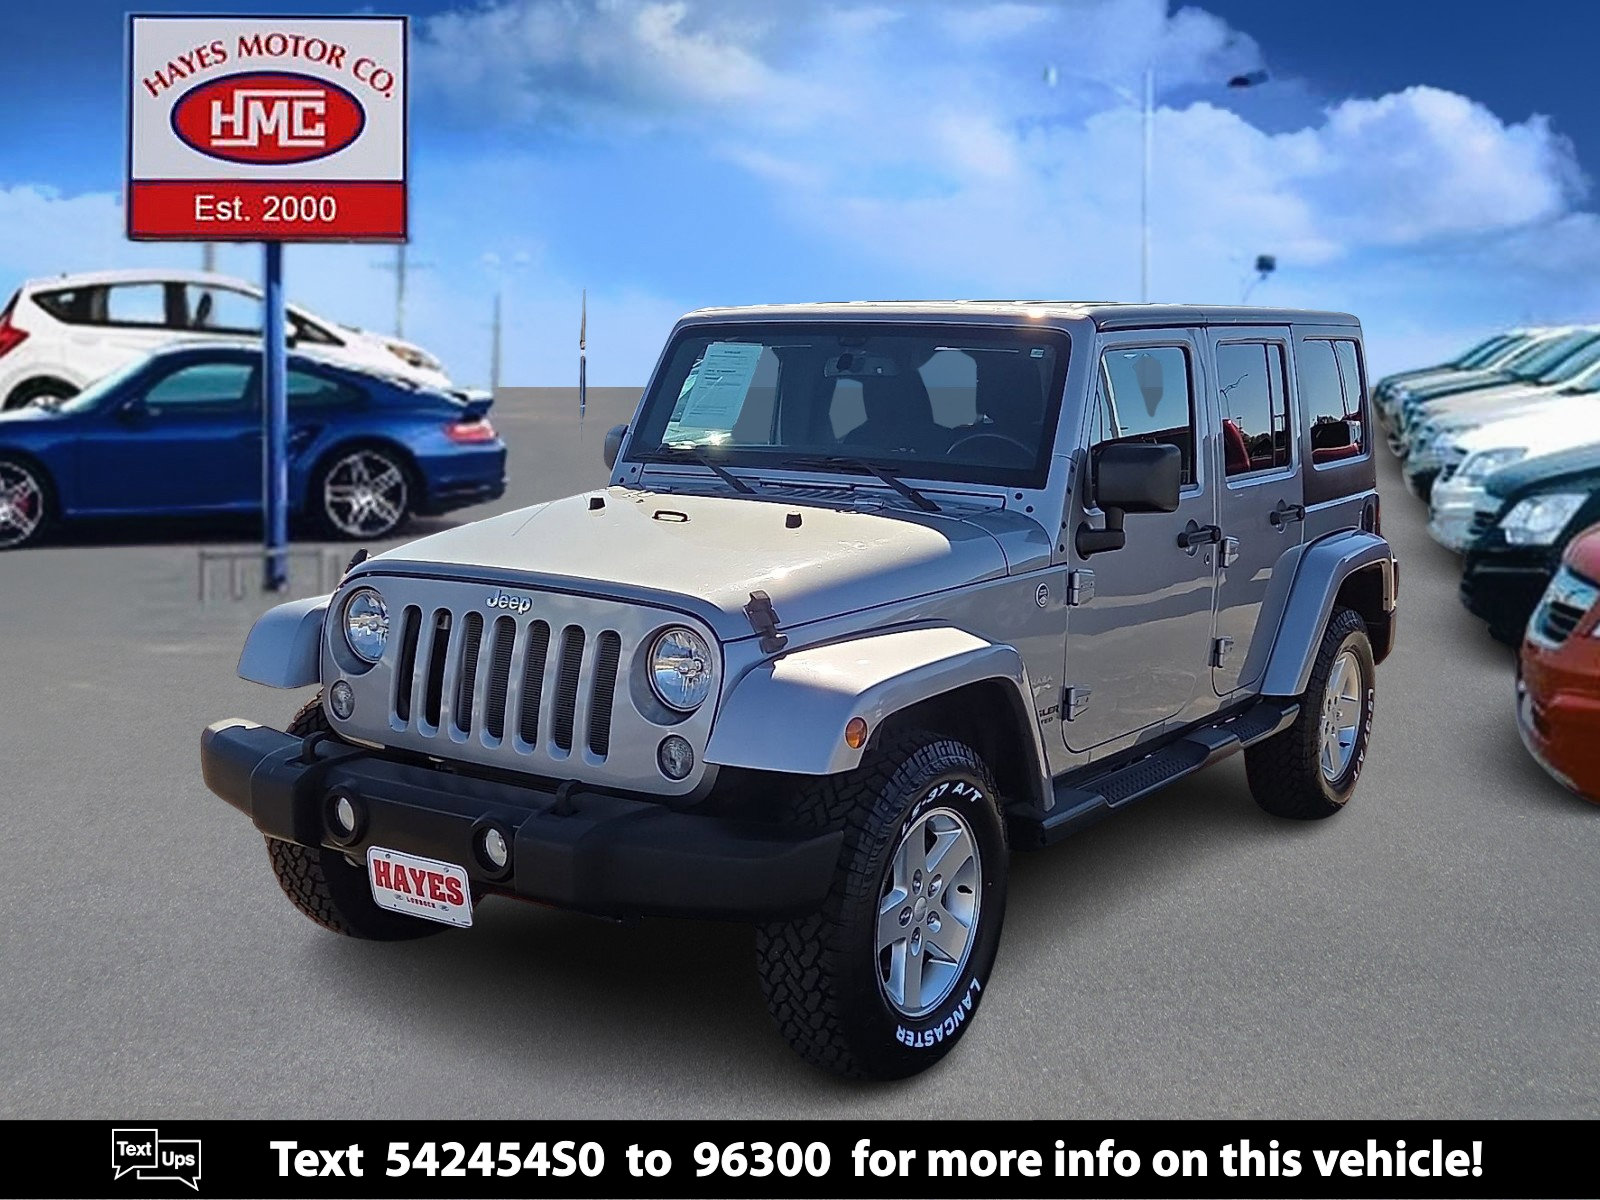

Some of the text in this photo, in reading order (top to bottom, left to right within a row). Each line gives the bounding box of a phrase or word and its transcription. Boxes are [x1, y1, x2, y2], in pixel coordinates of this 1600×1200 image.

[143, 33, 395, 98] HAYES MOTOR CO.
[210, 89, 326, 147] HMC
[195, 195, 337, 222] Est. 2000
[486, 589, 532, 615] Jeep
[952, 782, 983, 803] A/T
[373, 859, 464, 906] HAYES
[896, 977, 981, 1048] LANCASTER
